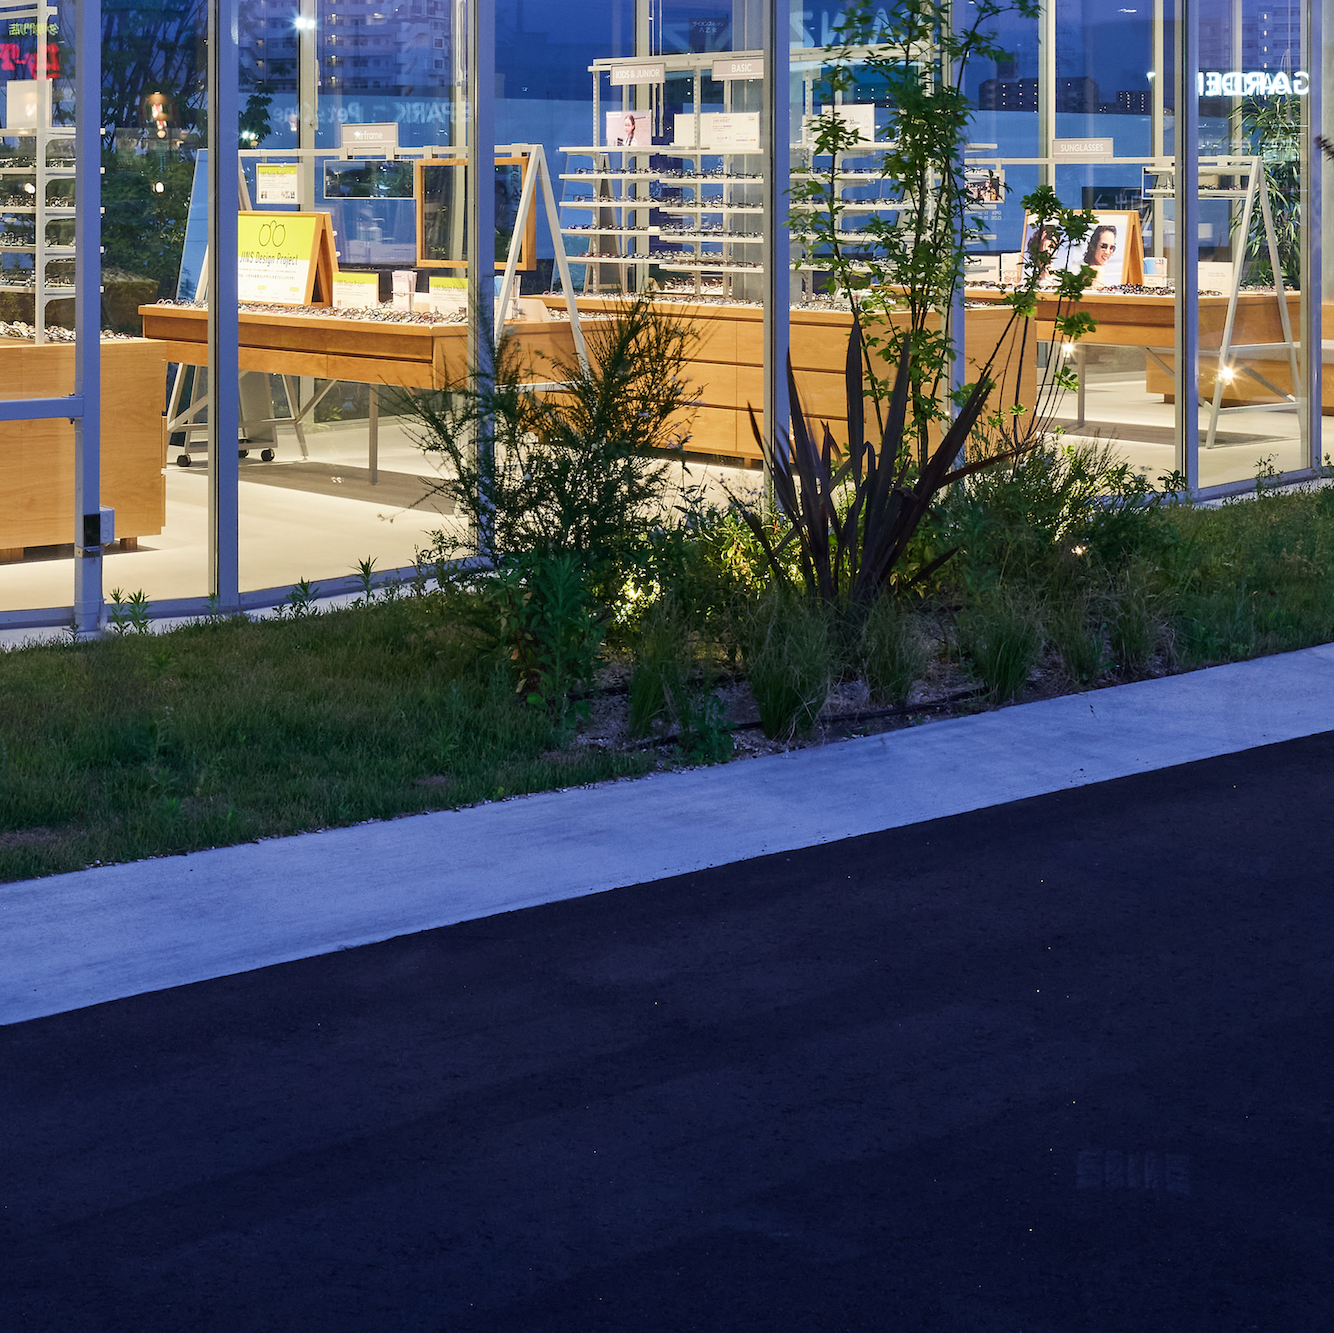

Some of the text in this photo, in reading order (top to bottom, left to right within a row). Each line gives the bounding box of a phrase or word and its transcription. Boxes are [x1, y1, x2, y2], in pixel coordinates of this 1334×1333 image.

[615, 68, 661, 79] KIDS & JUNIOR
[731, 63, 752, 73] BASIC
[354, 130, 384, 141] Airframe
[1060, 143, 1104, 152] SUNGLASSES
[239, 251, 299, 268] JINS Design Project
